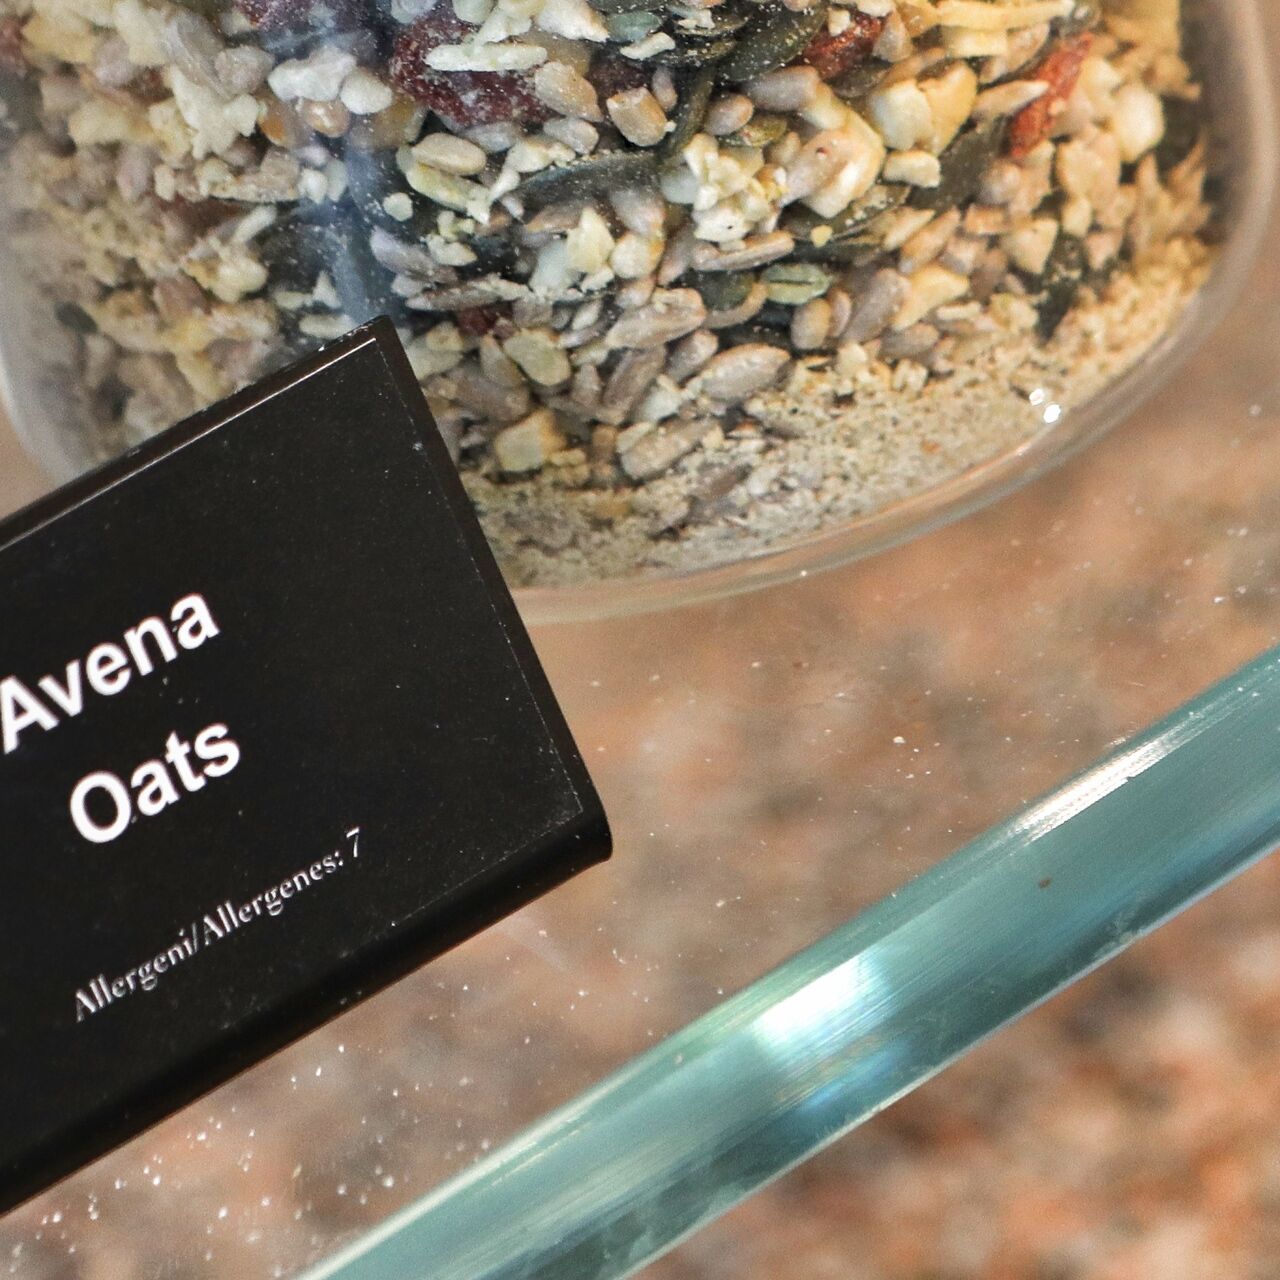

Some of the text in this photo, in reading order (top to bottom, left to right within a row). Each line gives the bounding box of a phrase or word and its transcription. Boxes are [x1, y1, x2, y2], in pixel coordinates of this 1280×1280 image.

[69, 723, 241, 844] Oats
[74, 825, 361, 1023] Allergeni/Allergenes: 7
